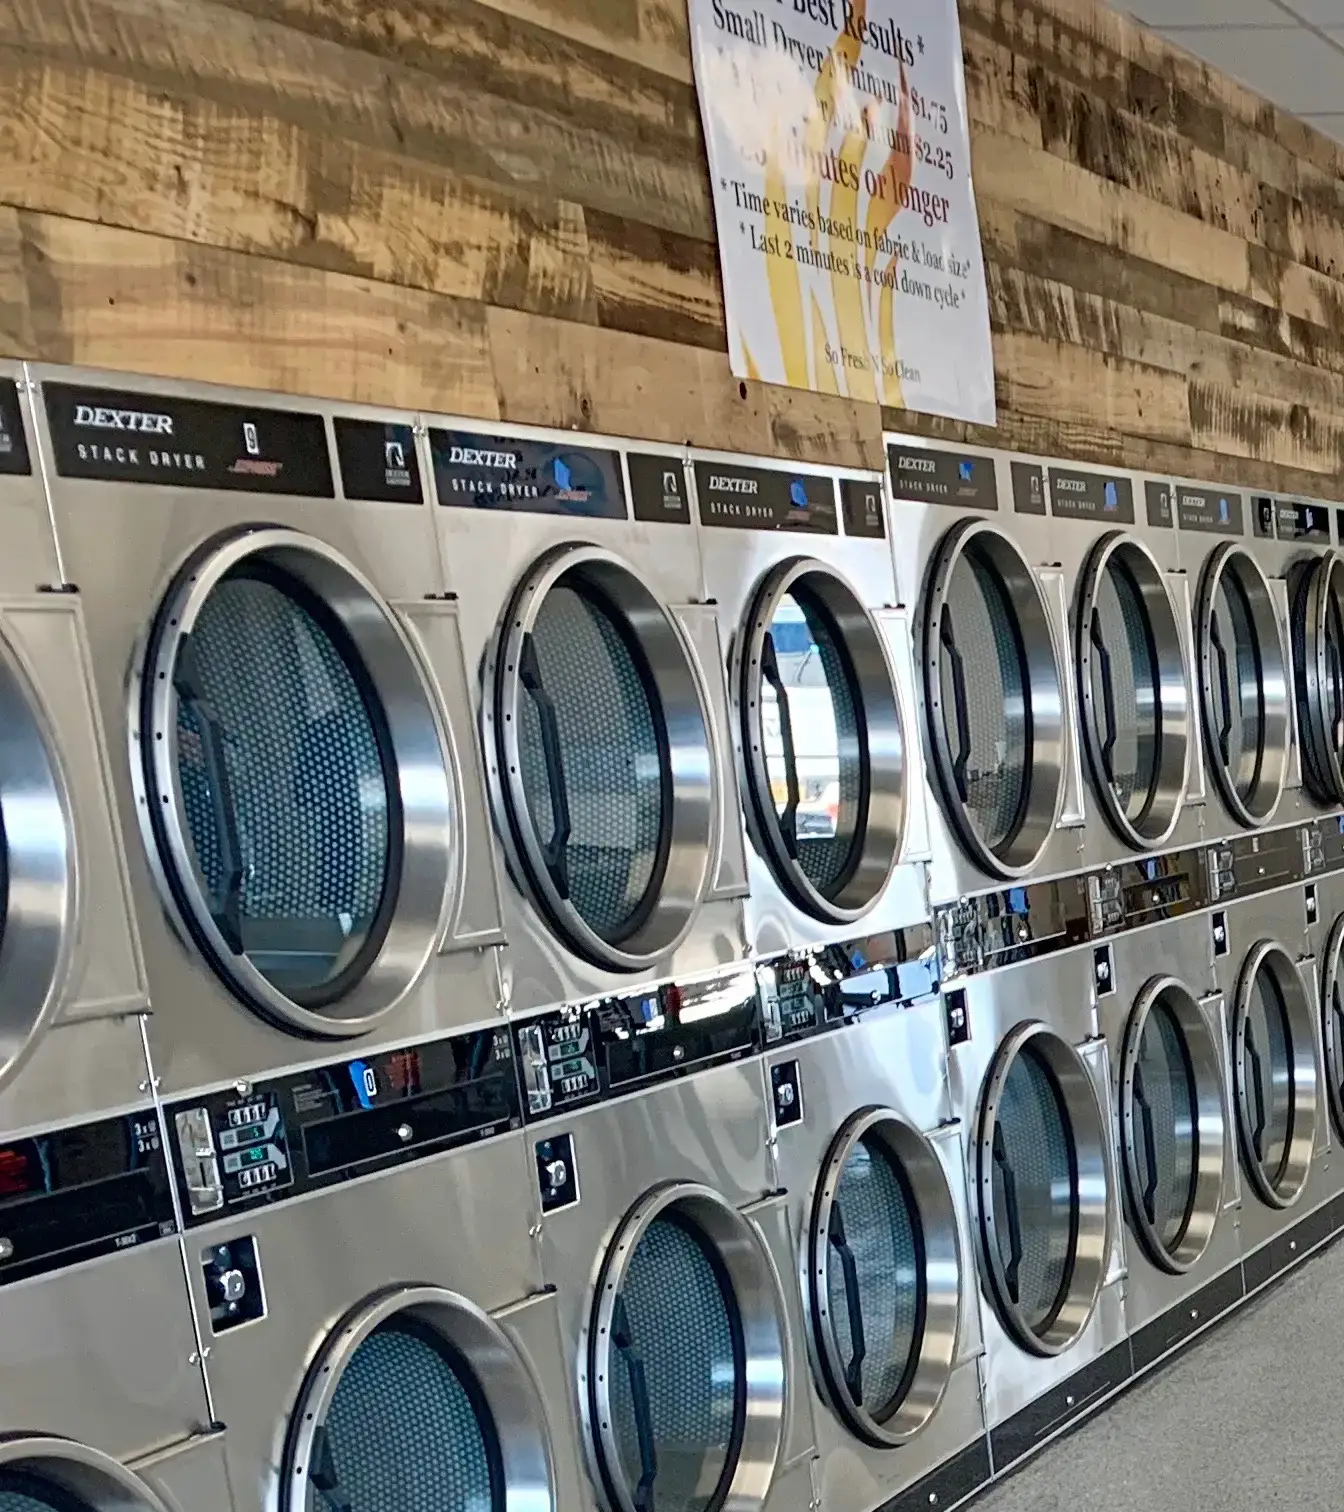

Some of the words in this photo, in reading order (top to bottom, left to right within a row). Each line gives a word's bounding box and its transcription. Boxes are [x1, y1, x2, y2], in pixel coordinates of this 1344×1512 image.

[842, 0, 914, 66] Results
[711, 0, 767, 48] Small
[911, 86, 948, 135] $1.75
[915, 134, 954, 180] $2.25
[865, 167, 887, 199] or
[892, 165, 950, 226] longer
[731, 180, 770, 216] Time
[772, 199, 815, 229] varies
[817, 206, 853, 242] based
[856, 228, 872, 249] on
[873, 227, 910, 260] fabric
[911, 240, 921, 265] &
[749, 224, 781, 257] Last
[784, 240, 794, 259] 2
[796, 240, 849, 275] minutes
[865, 266, 872, 283] a
[873, 266, 899, 291] cool
[901, 270, 932, 301] down
[934, 284, 960, 309] cycle
[895, 359, 921, 385] Clean
[74, 405, 174, 435] DEXTER
[77, 444, 140, 465] STACK
[149, 450, 206, 470] DRYER
[449, 447, 516, 469] DEXTER
[899, 456, 936, 473] DEXTER
[452, 478, 493, 494] STACK
[709, 476, 758, 494] DEXTER
